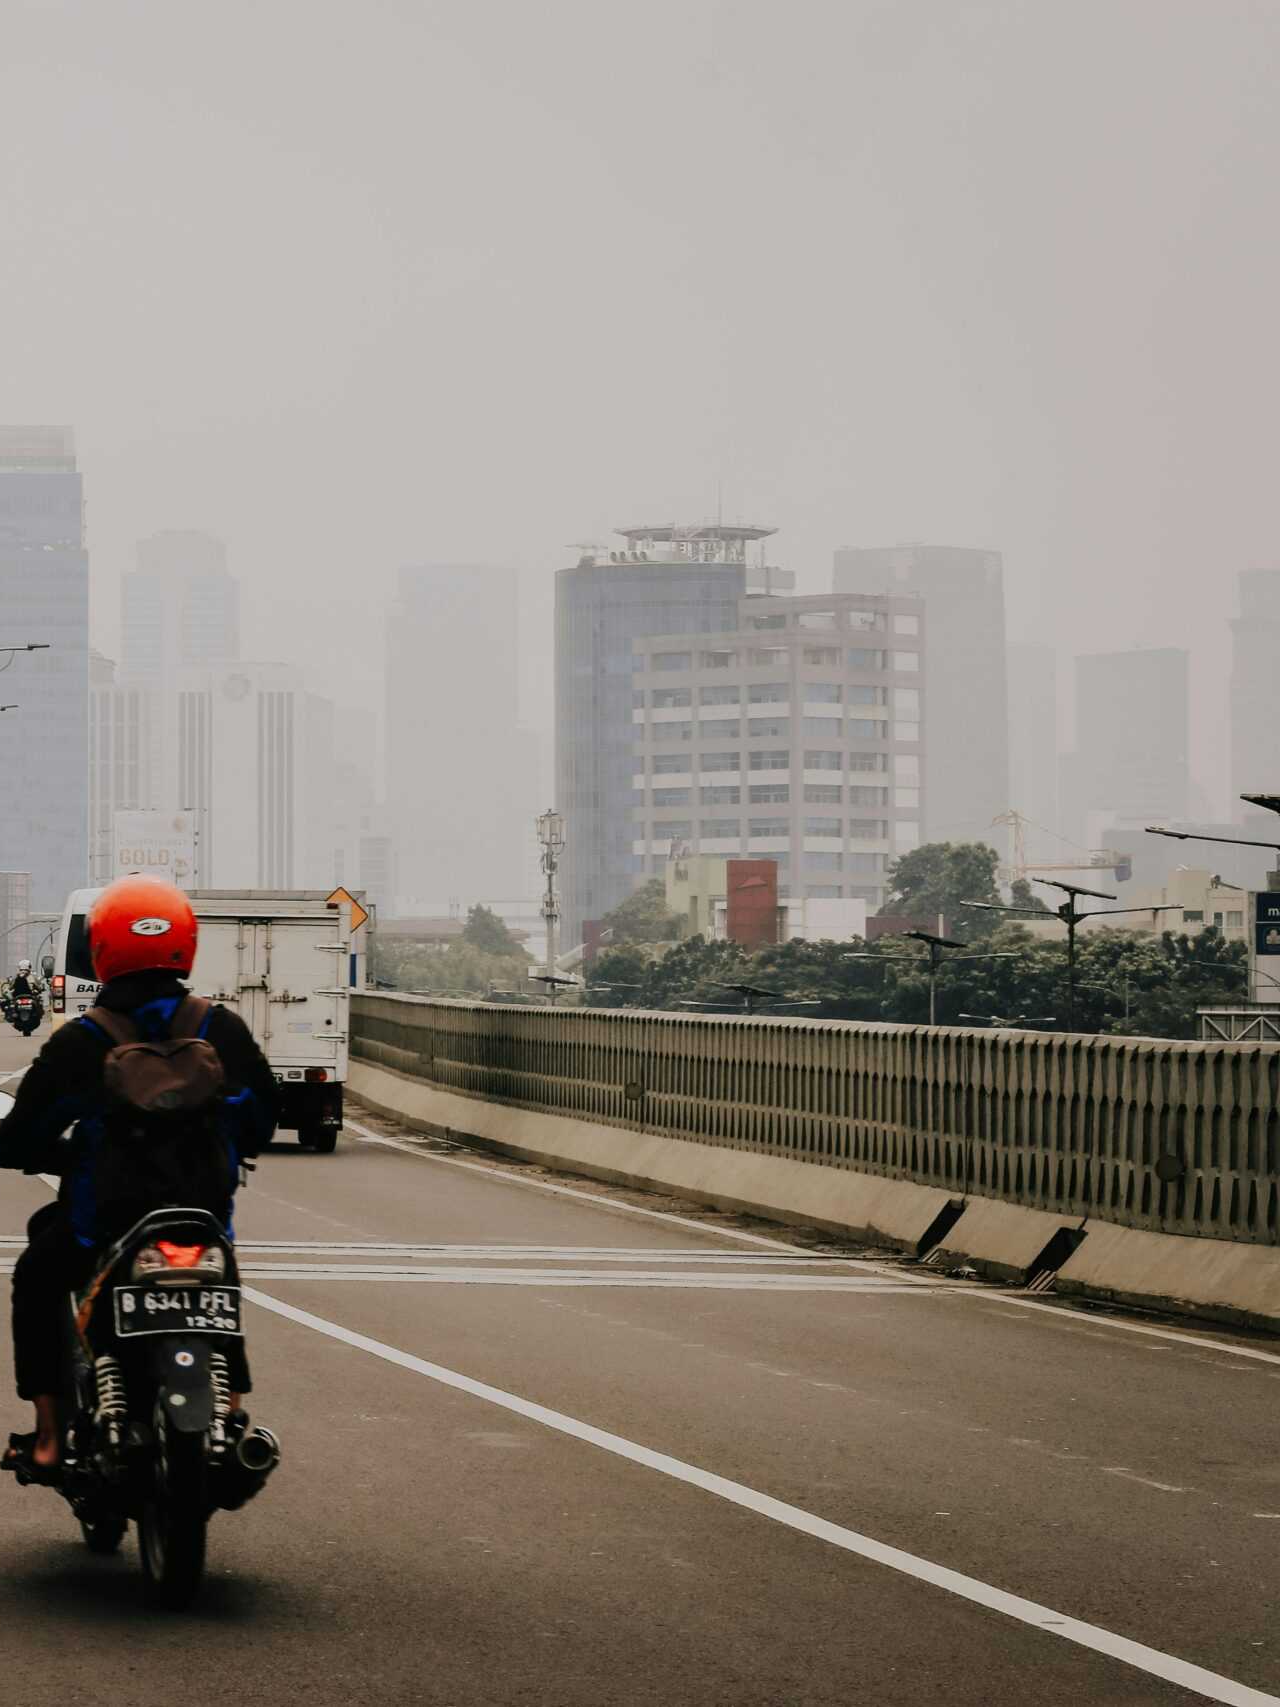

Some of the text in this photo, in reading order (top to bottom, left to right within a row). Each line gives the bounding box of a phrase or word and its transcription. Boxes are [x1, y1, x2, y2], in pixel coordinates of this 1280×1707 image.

[120, 850, 169, 865] GOLD
[122, 1292, 237, 1313] B 6341 PFL
